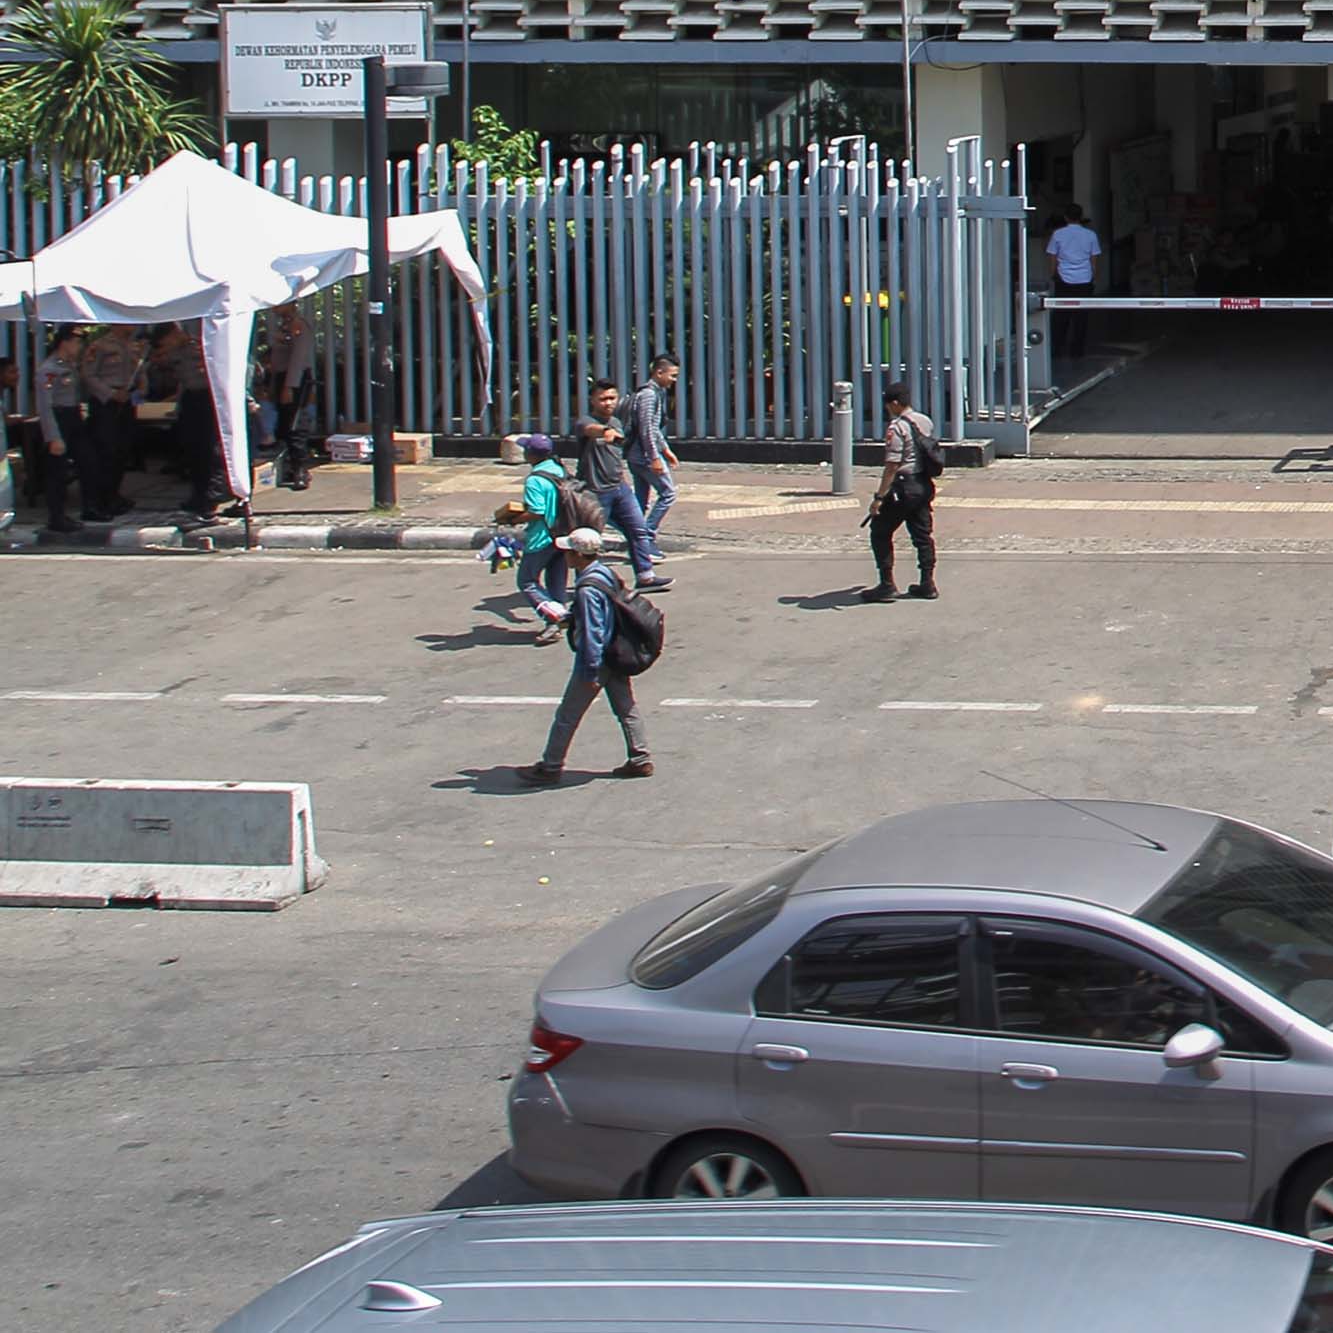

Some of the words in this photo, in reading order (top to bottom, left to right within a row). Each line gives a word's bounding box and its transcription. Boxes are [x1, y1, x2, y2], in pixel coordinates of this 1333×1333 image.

[235, 45, 262, 57] DEWAN
[264, 45, 319, 57] KEHORMATAN
[320, 44, 386, 57] PENYELENGGARA
[387, 43, 417, 56] PEMILU
[284, 58, 323, 70] REPUBLIK
[300, 72, 353, 88] DKPP
